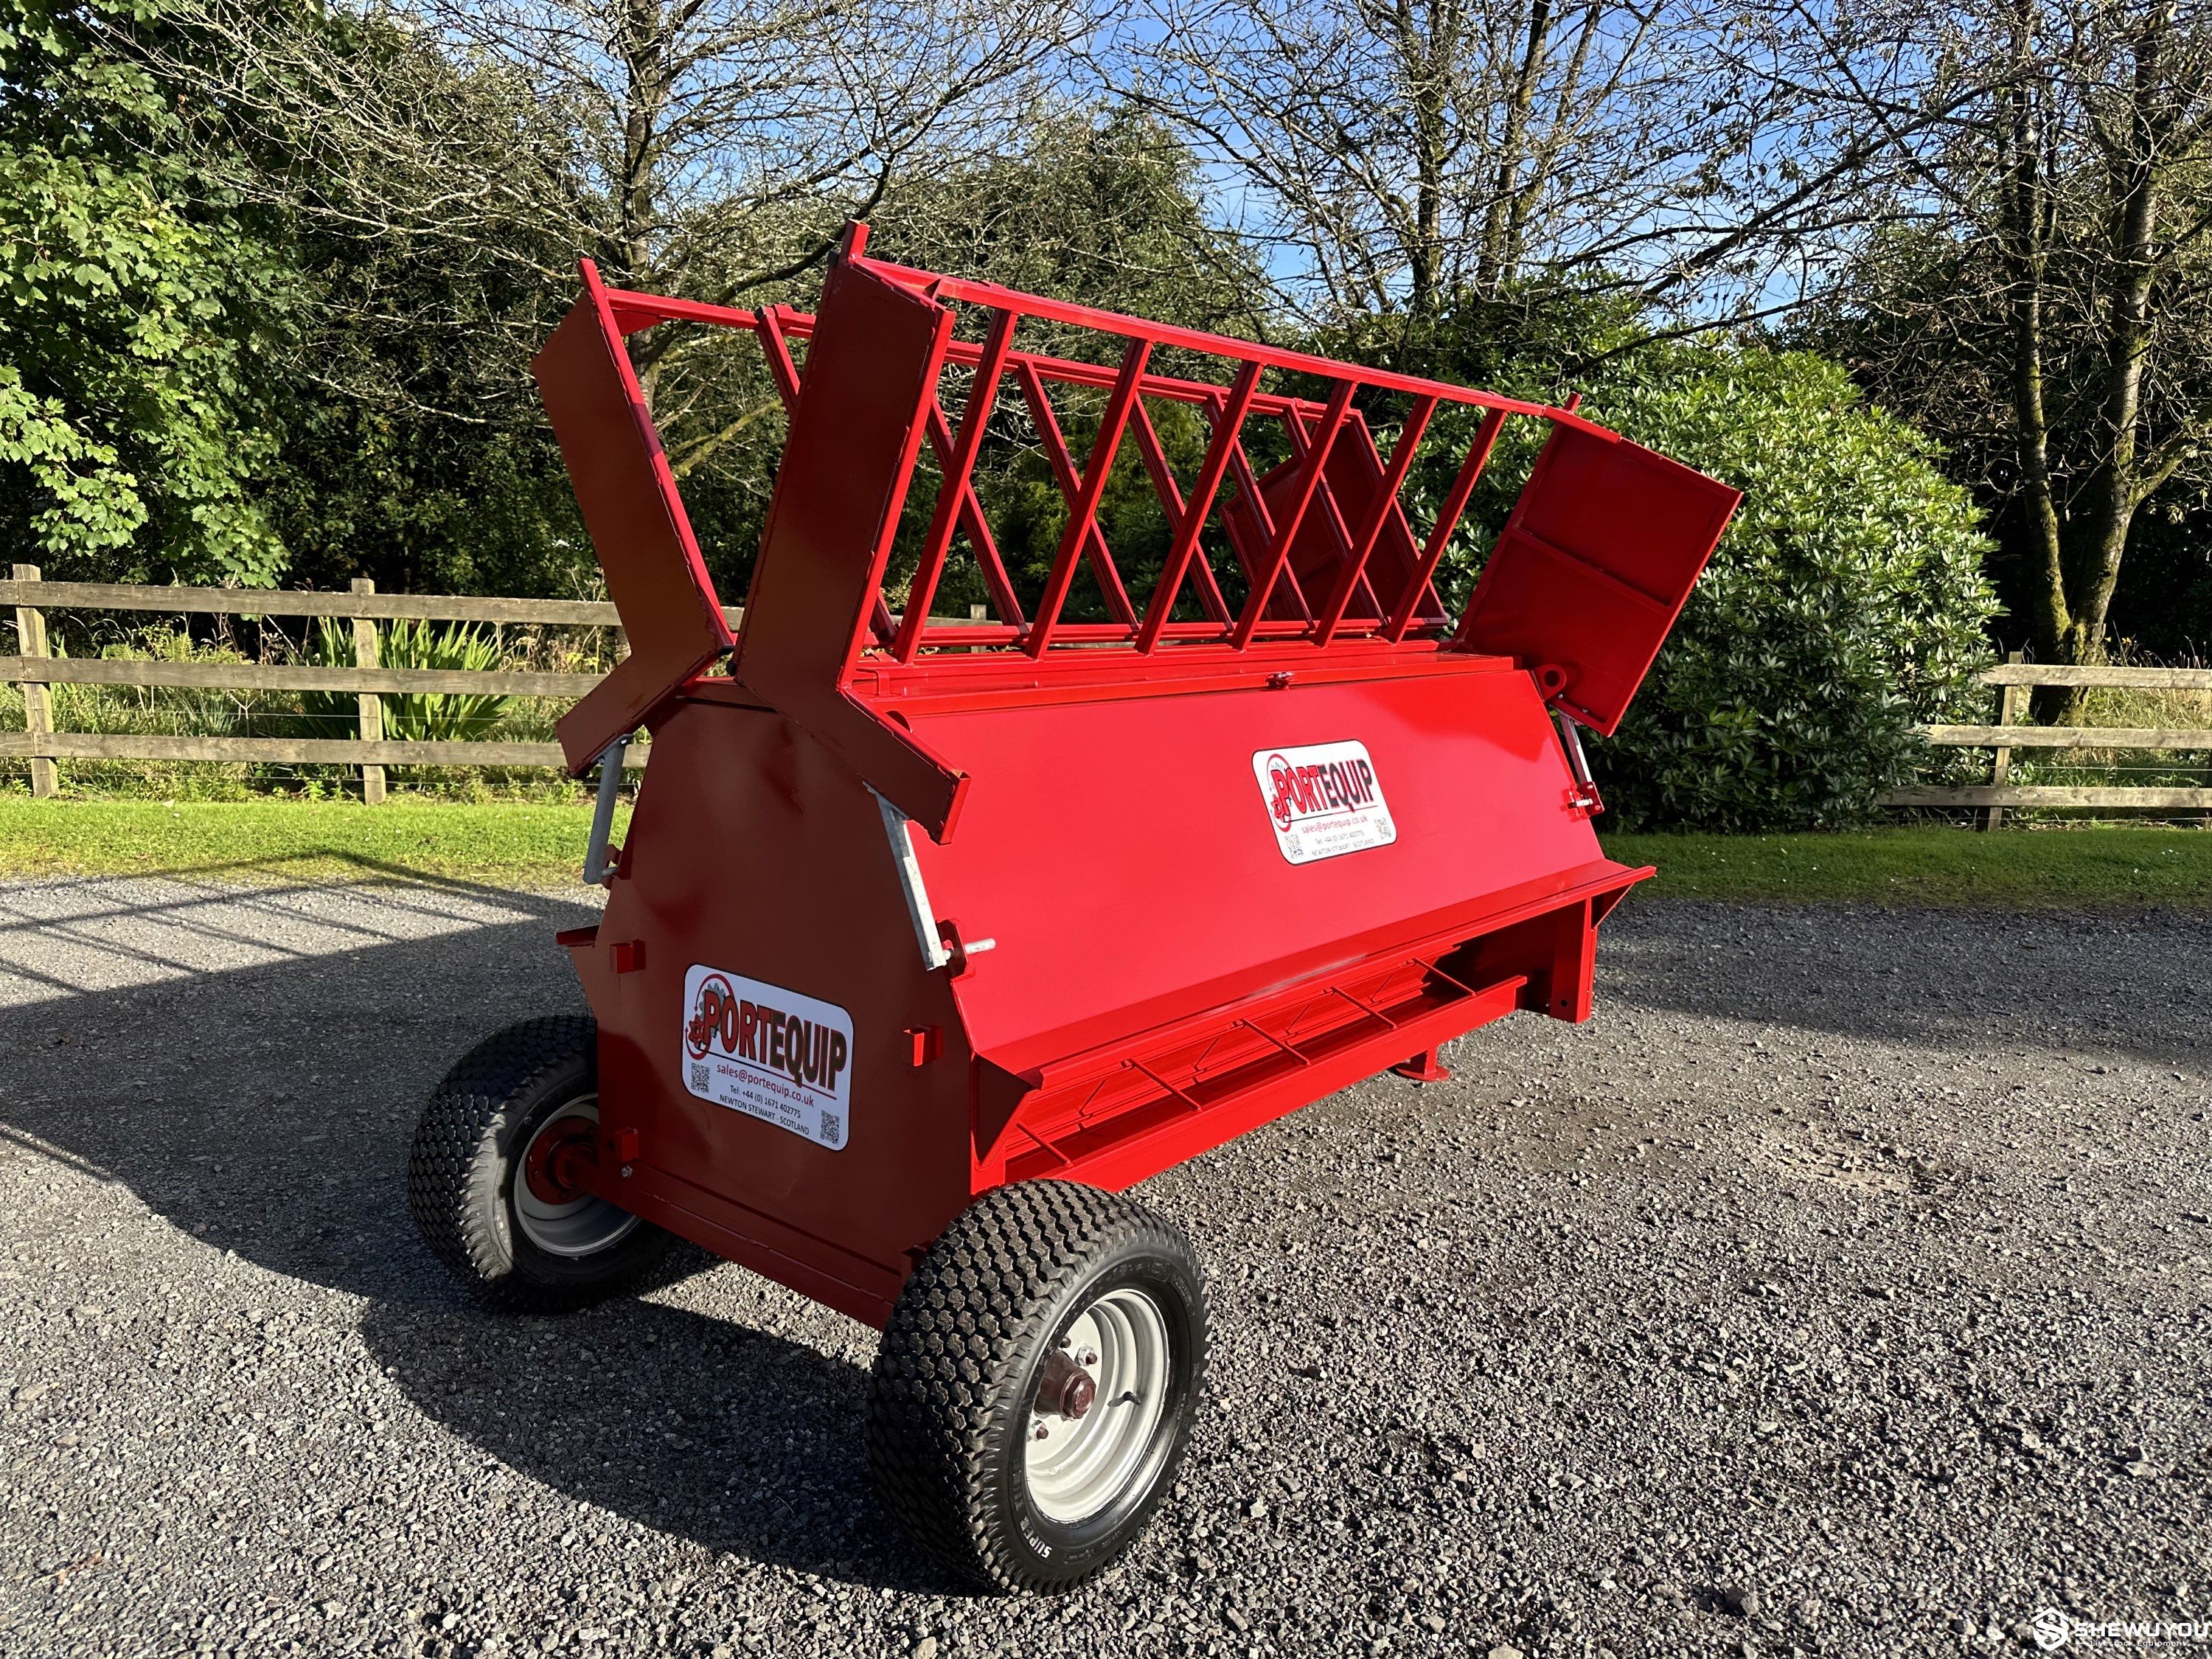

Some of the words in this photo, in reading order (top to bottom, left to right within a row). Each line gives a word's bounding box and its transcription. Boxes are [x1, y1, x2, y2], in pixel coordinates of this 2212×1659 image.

[1270, 759, 1374, 815] PORTEQUIP
[1312, 848, 1331, 856] NEWTON
[1331, 844, 1350, 852] STEWART
[1353, 838, 1374, 848] SCOTLAND
[703, 989, 846, 1091] PORTEQUIP
[717, 1064, 814, 1107] sales@portequip.co.uk
[730, 1085, 741, 1096] Tel:
[742, 1090, 754, 1099] +44
[754, 1093, 763, 1105] (0)
[765, 1096, 778, 1109] 1671
[779, 1103, 801, 1119] 402775
[720, 1094, 747, 1110] NEWTON
[748, 1104, 776, 1121] STEWART
[779, 1116, 810, 1135] SCOTLAND
[1020, 1517, 1052, 1558] SUPER
